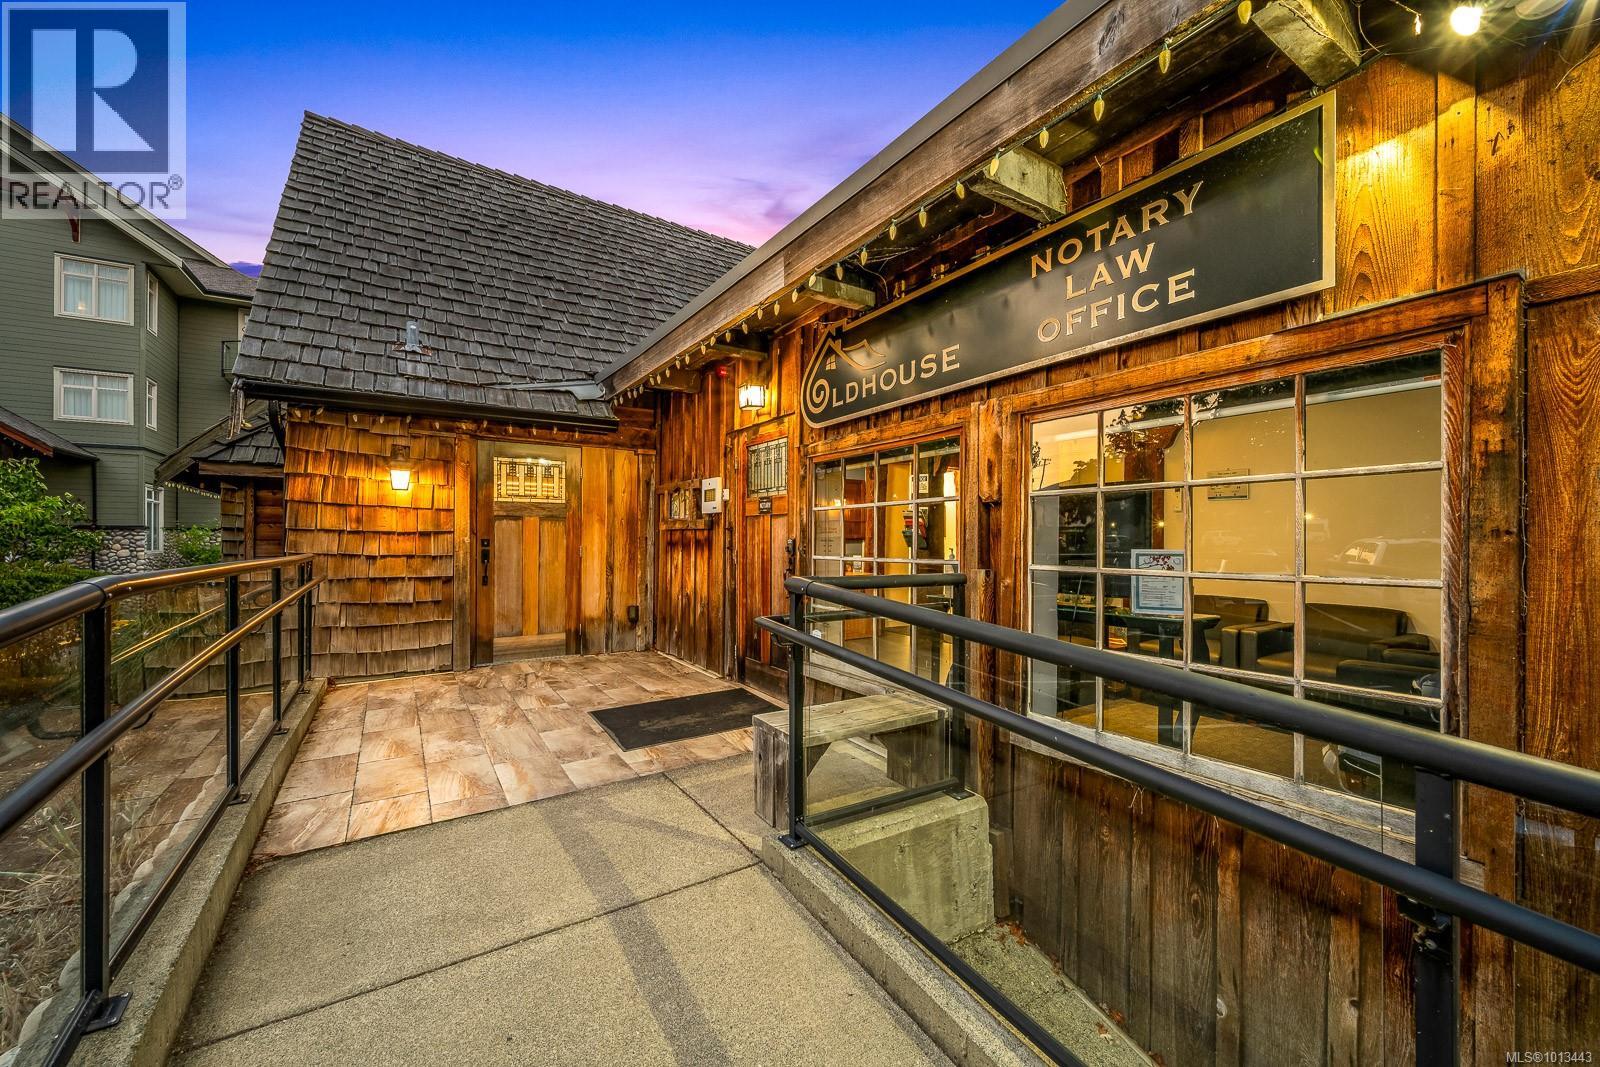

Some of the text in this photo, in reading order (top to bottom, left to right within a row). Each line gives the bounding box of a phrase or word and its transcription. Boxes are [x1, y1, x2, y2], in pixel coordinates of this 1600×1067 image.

[1031, 180, 1204, 279] NOTARY
[1037, 267, 1196, 343] OFFICE
[1065, 242, 1156, 300] LAW
